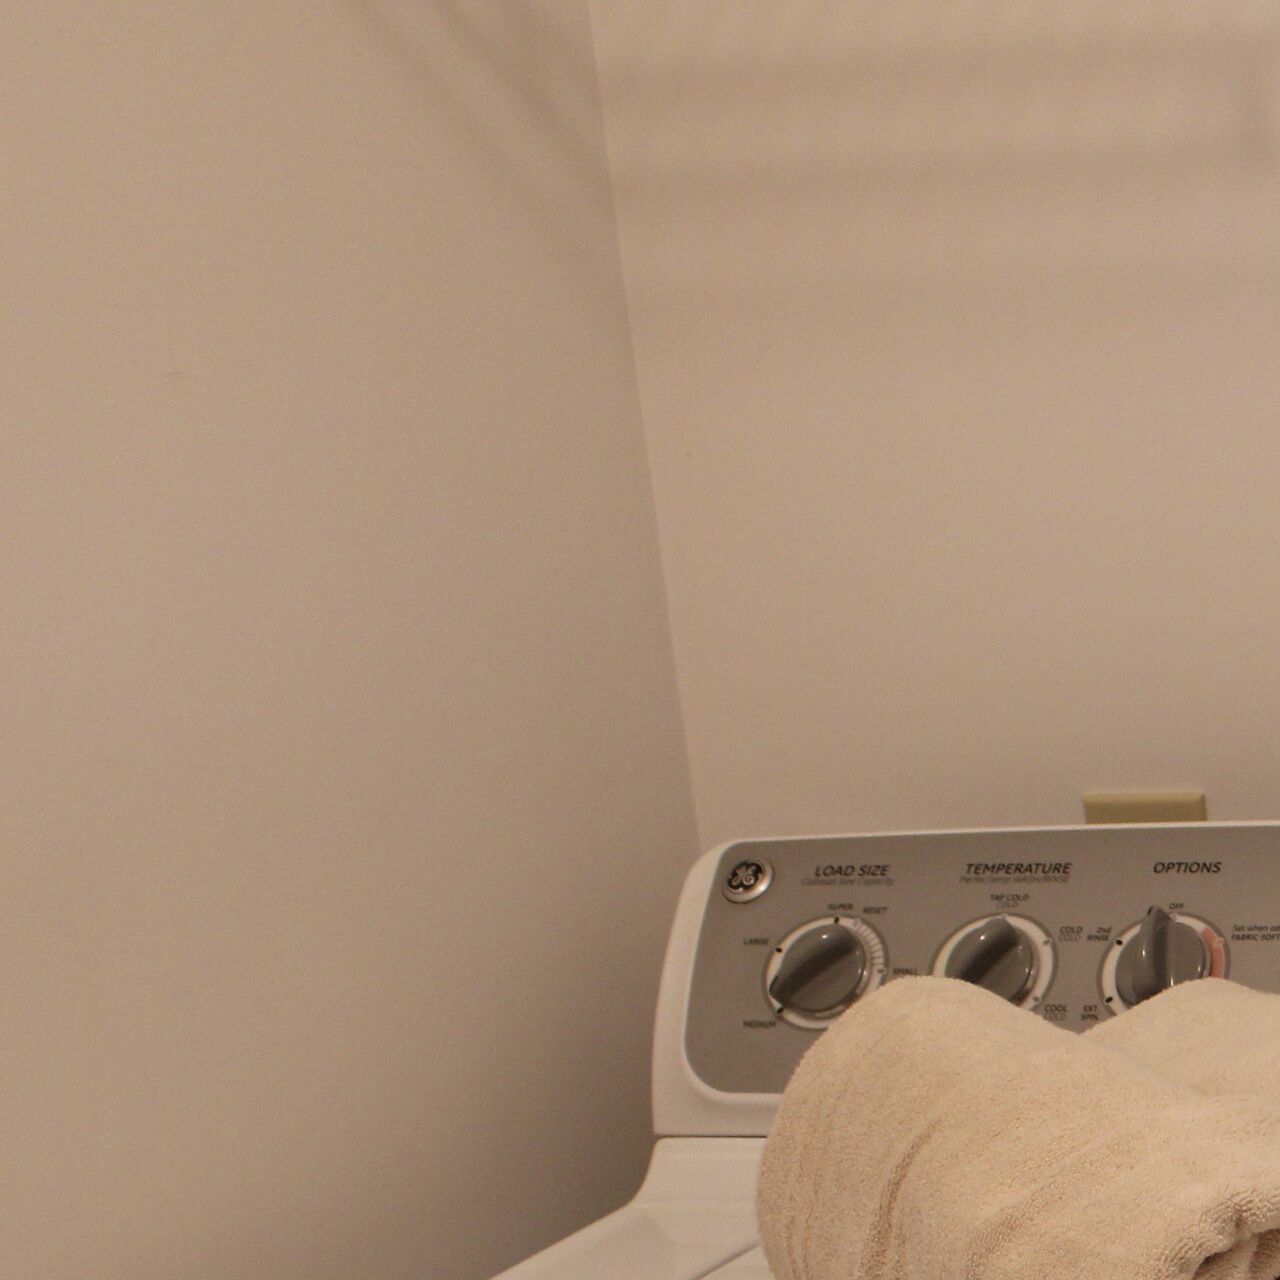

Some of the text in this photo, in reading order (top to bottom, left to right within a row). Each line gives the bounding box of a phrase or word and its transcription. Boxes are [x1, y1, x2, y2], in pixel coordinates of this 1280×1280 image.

[814, 864, 890, 877] LOAD SIZE
[965, 862, 1072, 875] TEMPERATURE
[1153, 862, 1222, 874] OPTIONS
[828, 903, 853, 911] SUPER
[862, 906, 888, 914] RESET
[1059, 926, 1083, 935] COLD
[1231, 933, 1258, 941] FABRIC
